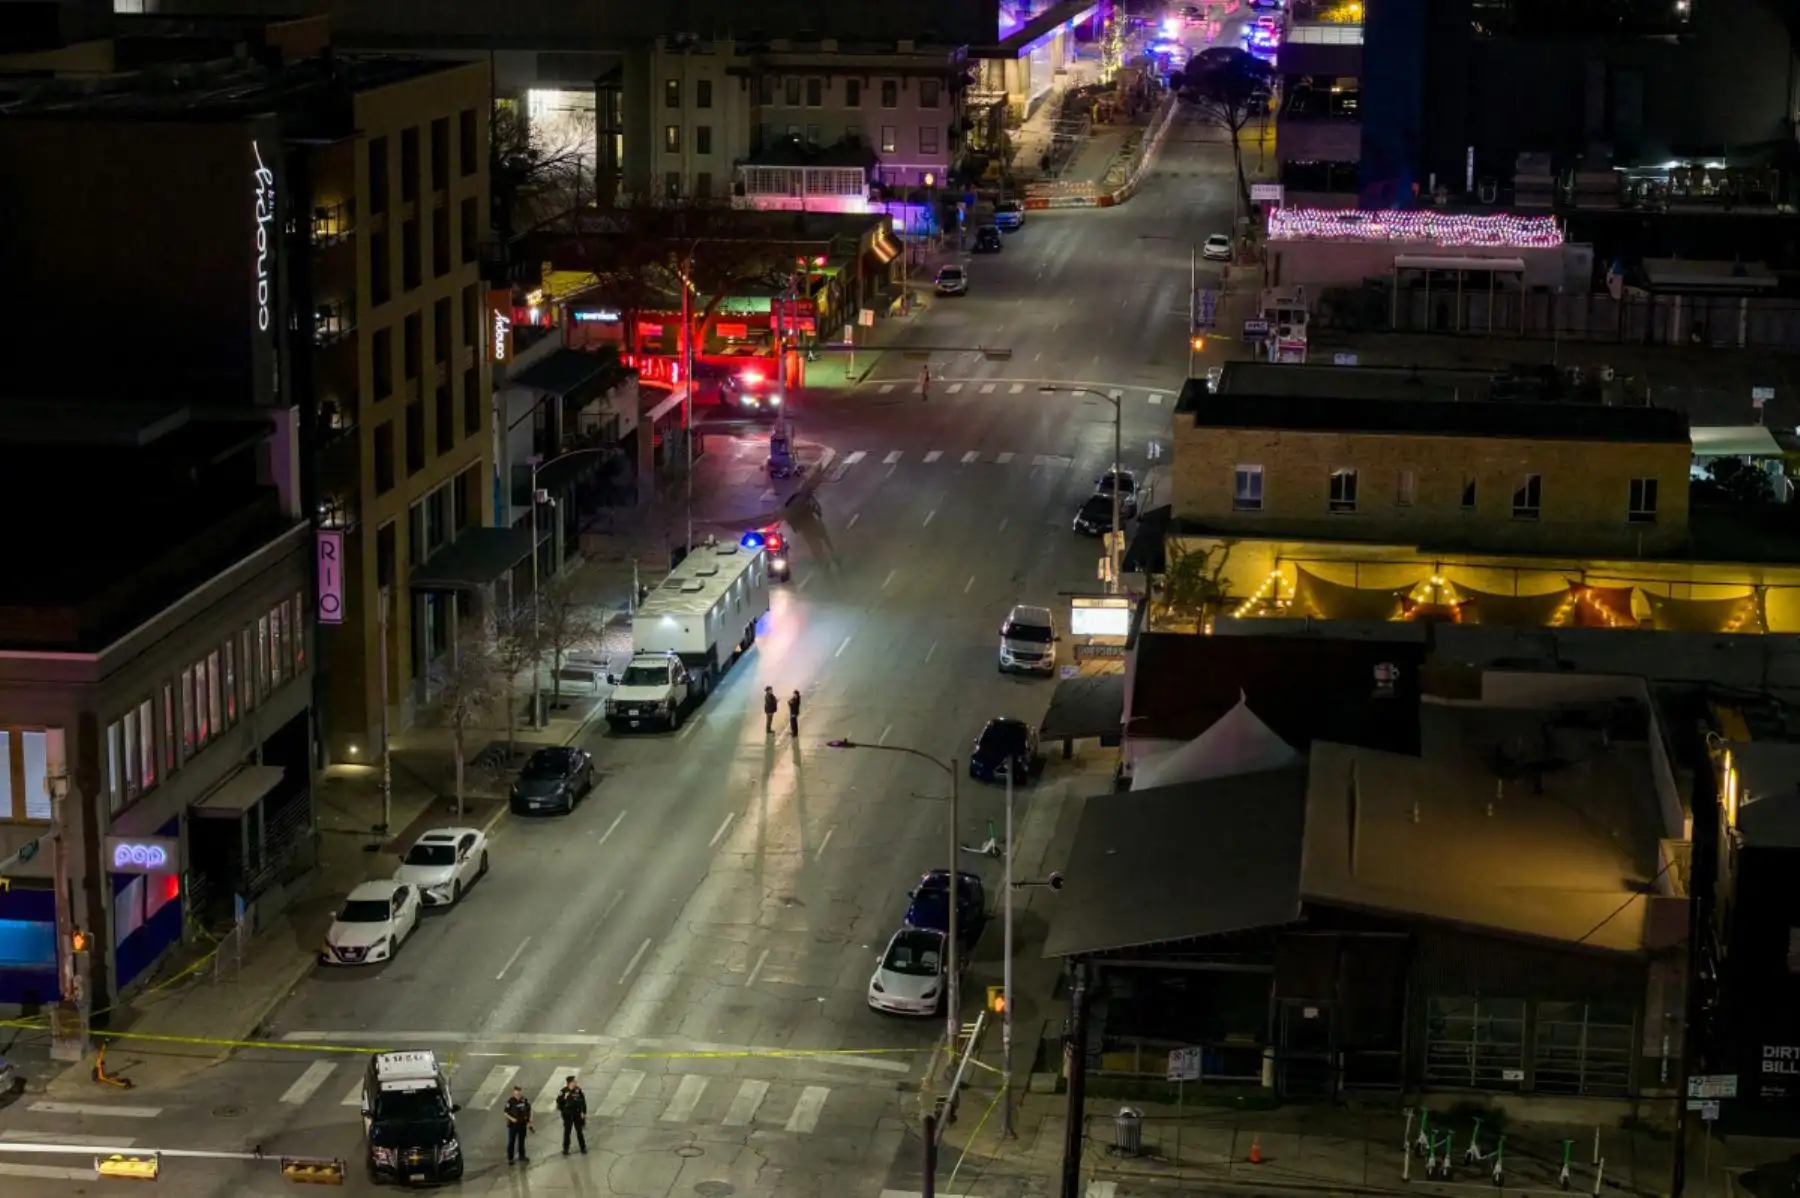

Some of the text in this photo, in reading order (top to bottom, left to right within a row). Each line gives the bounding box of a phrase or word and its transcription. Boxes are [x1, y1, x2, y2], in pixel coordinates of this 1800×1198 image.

[251, 139, 273, 332] canopy
[320, 540, 340, 614] RIO
[114, 843, 166, 868] pop
[1762, 1046, 1800, 1059] DIRT
[1761, 1060, 1800, 1073] BILL
